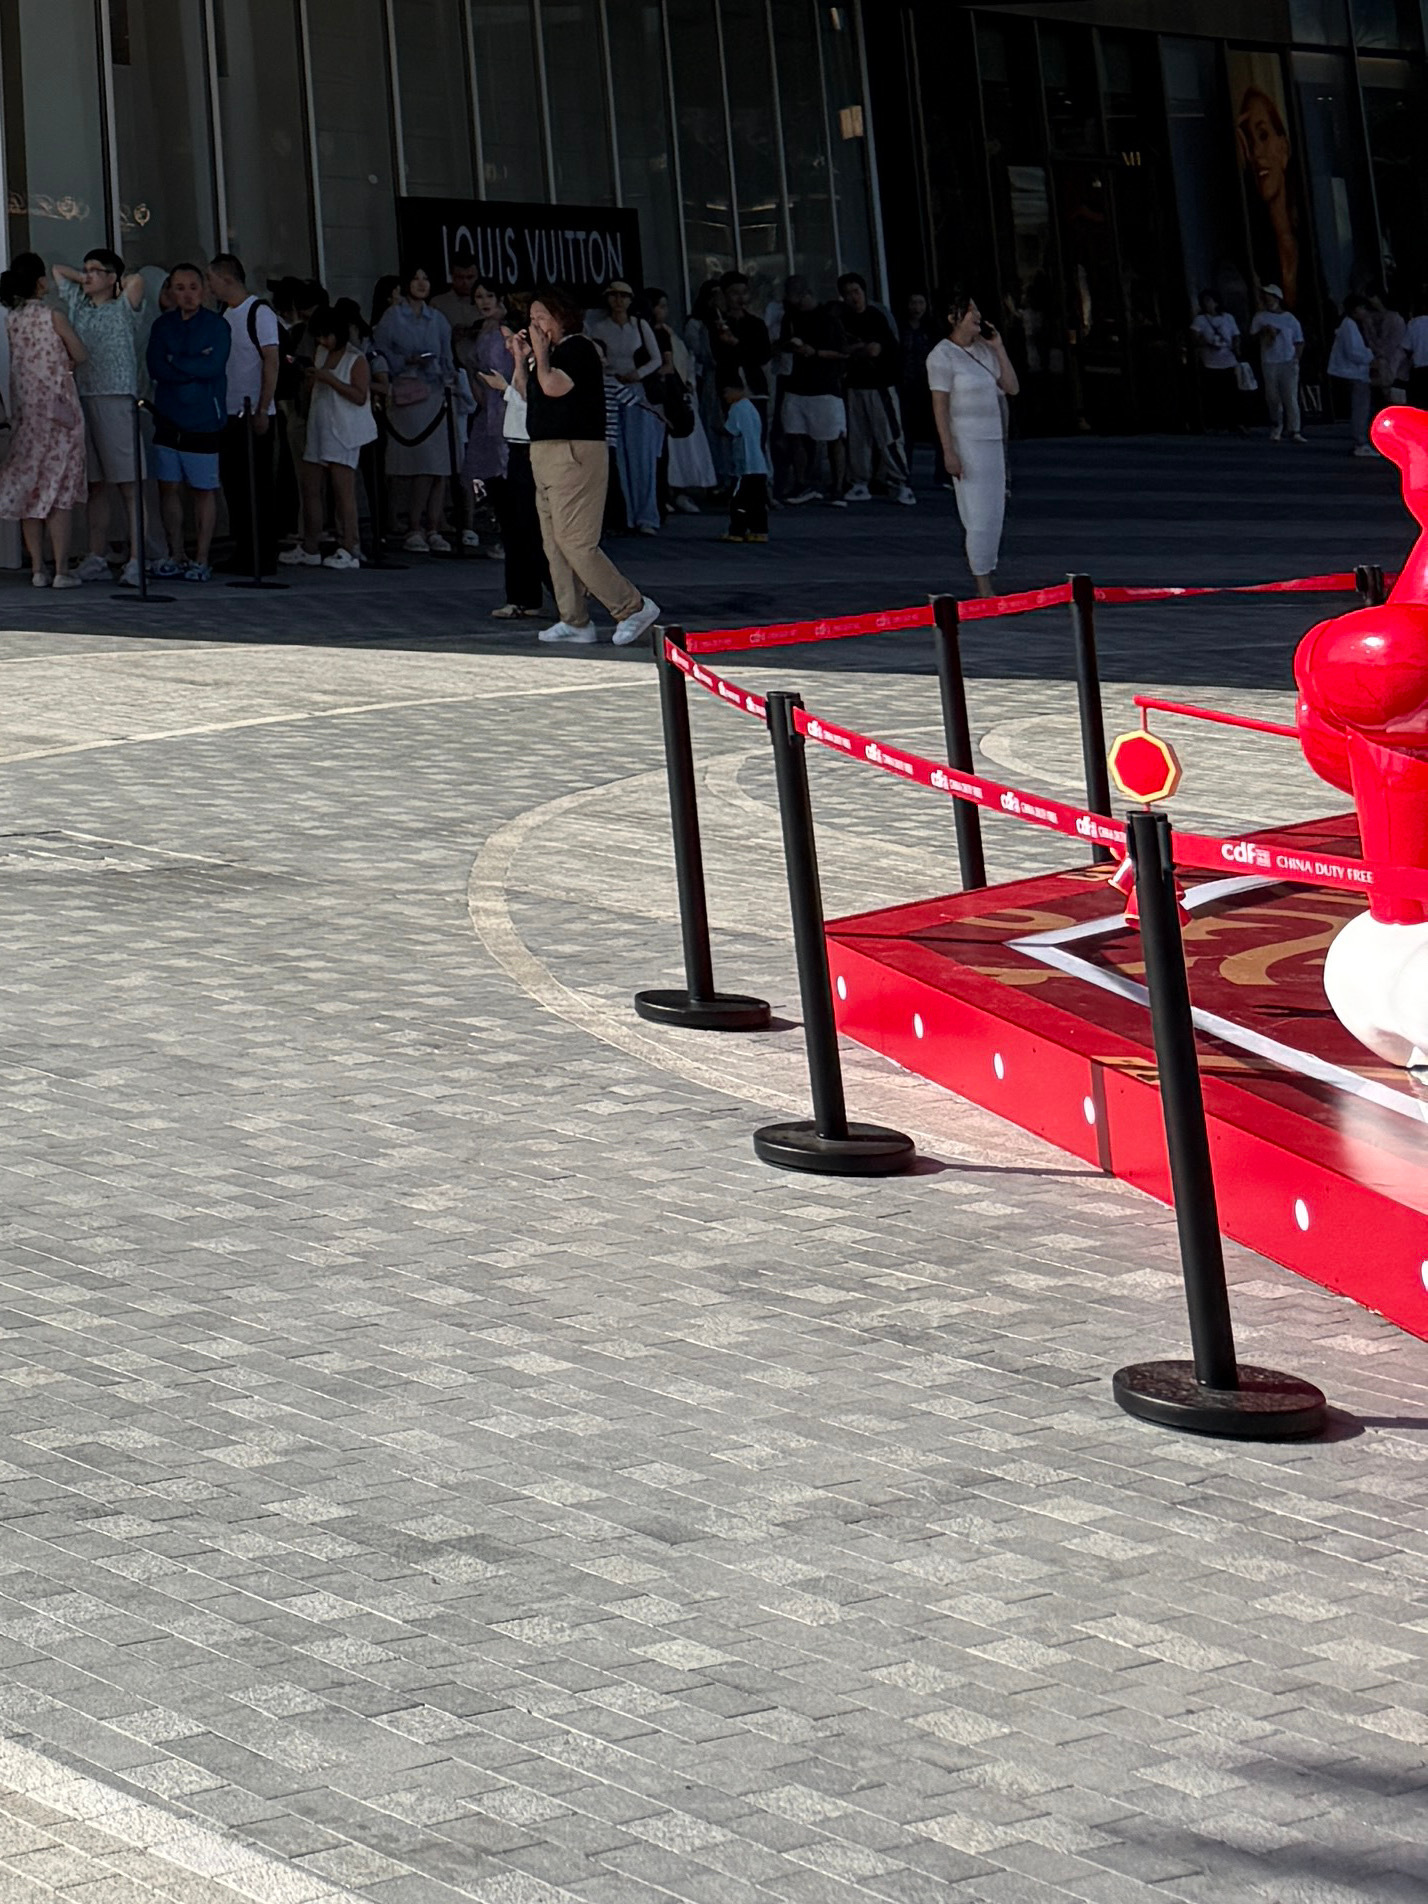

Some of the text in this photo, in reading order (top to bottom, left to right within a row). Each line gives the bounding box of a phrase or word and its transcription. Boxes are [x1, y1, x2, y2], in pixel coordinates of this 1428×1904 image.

[525, 229, 624, 284] VUITTON
[1276, 855, 1313, 874] CHINA
[1315, 862, 1345, 879] DUTY
[1347, 868, 1374, 884] FREE
